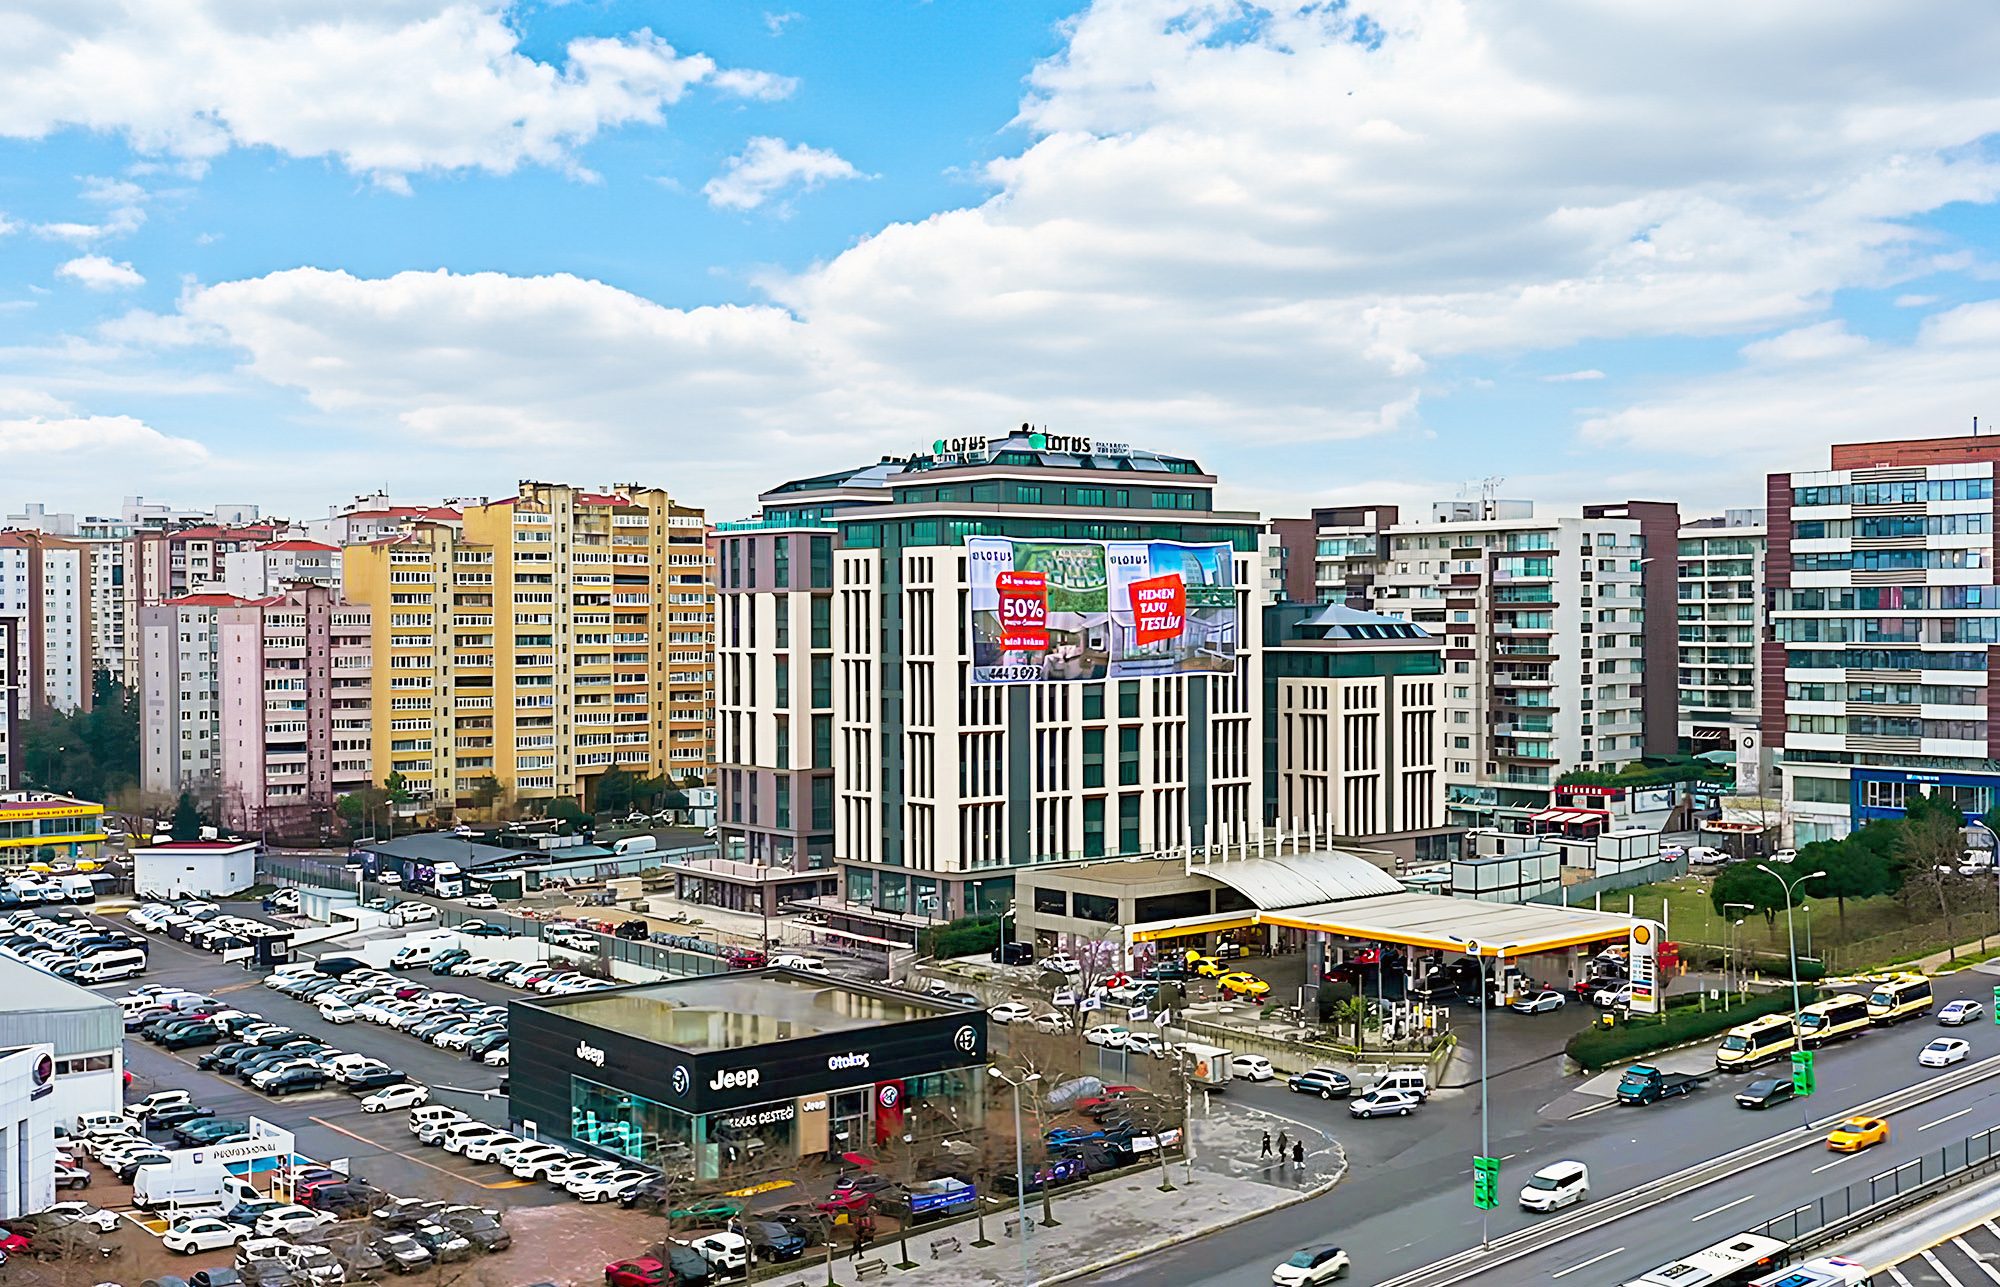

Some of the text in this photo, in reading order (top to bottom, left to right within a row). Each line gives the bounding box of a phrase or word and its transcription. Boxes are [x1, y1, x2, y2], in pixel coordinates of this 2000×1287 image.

[943, 436, 987, 453] LOTUS
[1045, 434, 1091, 453] LOTUS
[1003, 598, 1044, 618] 50%
[576, 1040, 605, 1067] Jeep
[709, 1068, 760, 1091] Jeep
